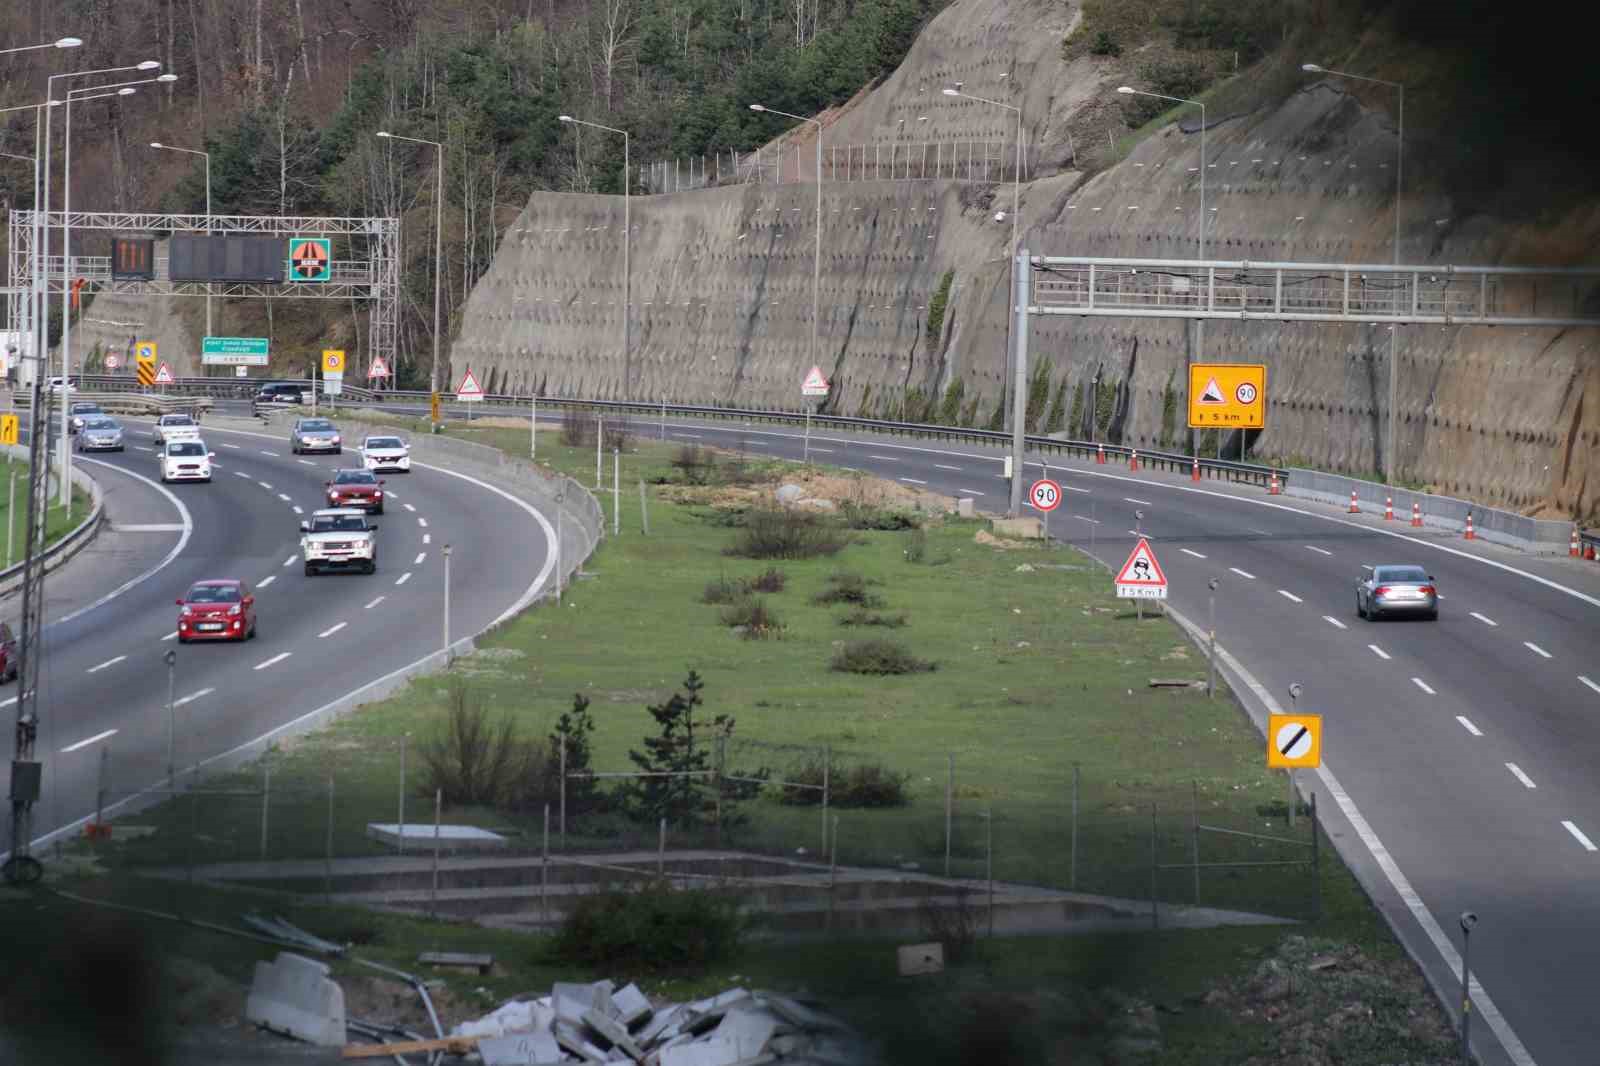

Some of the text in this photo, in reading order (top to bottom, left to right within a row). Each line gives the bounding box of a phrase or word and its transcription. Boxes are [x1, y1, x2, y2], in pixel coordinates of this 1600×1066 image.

[1240, 388, 1254, 399] 90
[1212, 413, 1219, 421] 5
[1036, 488, 1054, 502] 90
